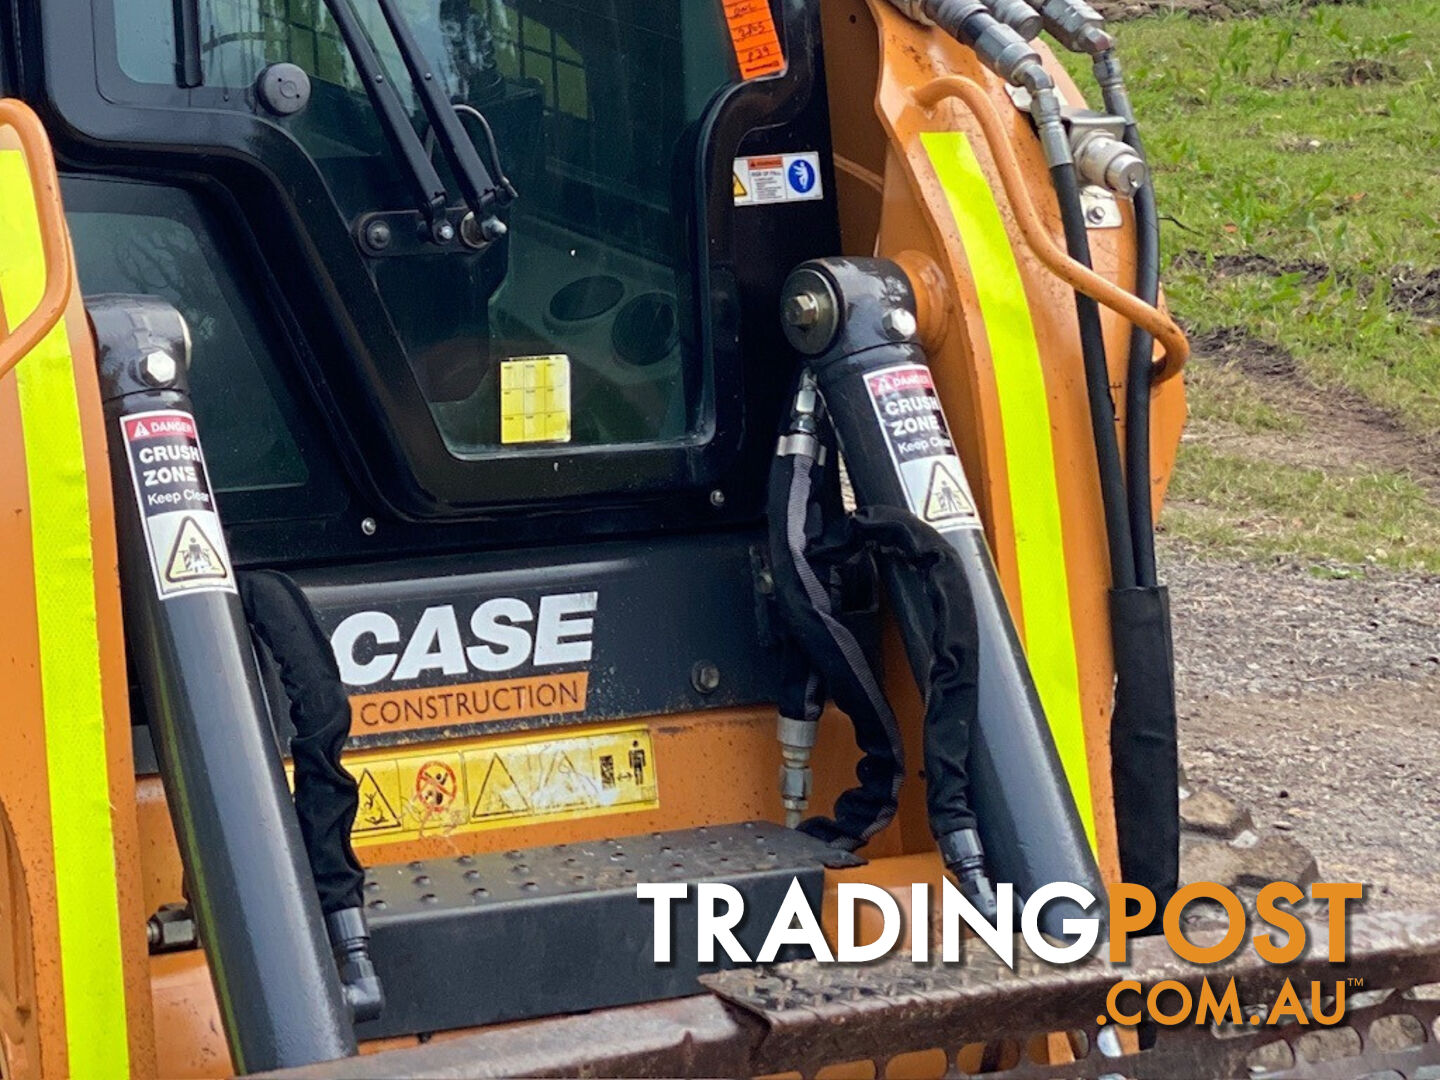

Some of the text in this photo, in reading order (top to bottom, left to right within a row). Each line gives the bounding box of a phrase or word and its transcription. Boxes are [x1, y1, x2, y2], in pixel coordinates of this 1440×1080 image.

[885, 396, 940, 416] CRUSH
[150, 421, 193, 433] DANGER
[891, 415, 940, 436] ZONE
[139, 444, 201, 464] CRUSH
[897, 440, 929, 454] Keep
[143, 466, 198, 487] ZONE
[147, 491, 182, 506] Keep
[331, 591, 598, 686] CASE
[360, 680, 579, 727] CONSTRUCTION
